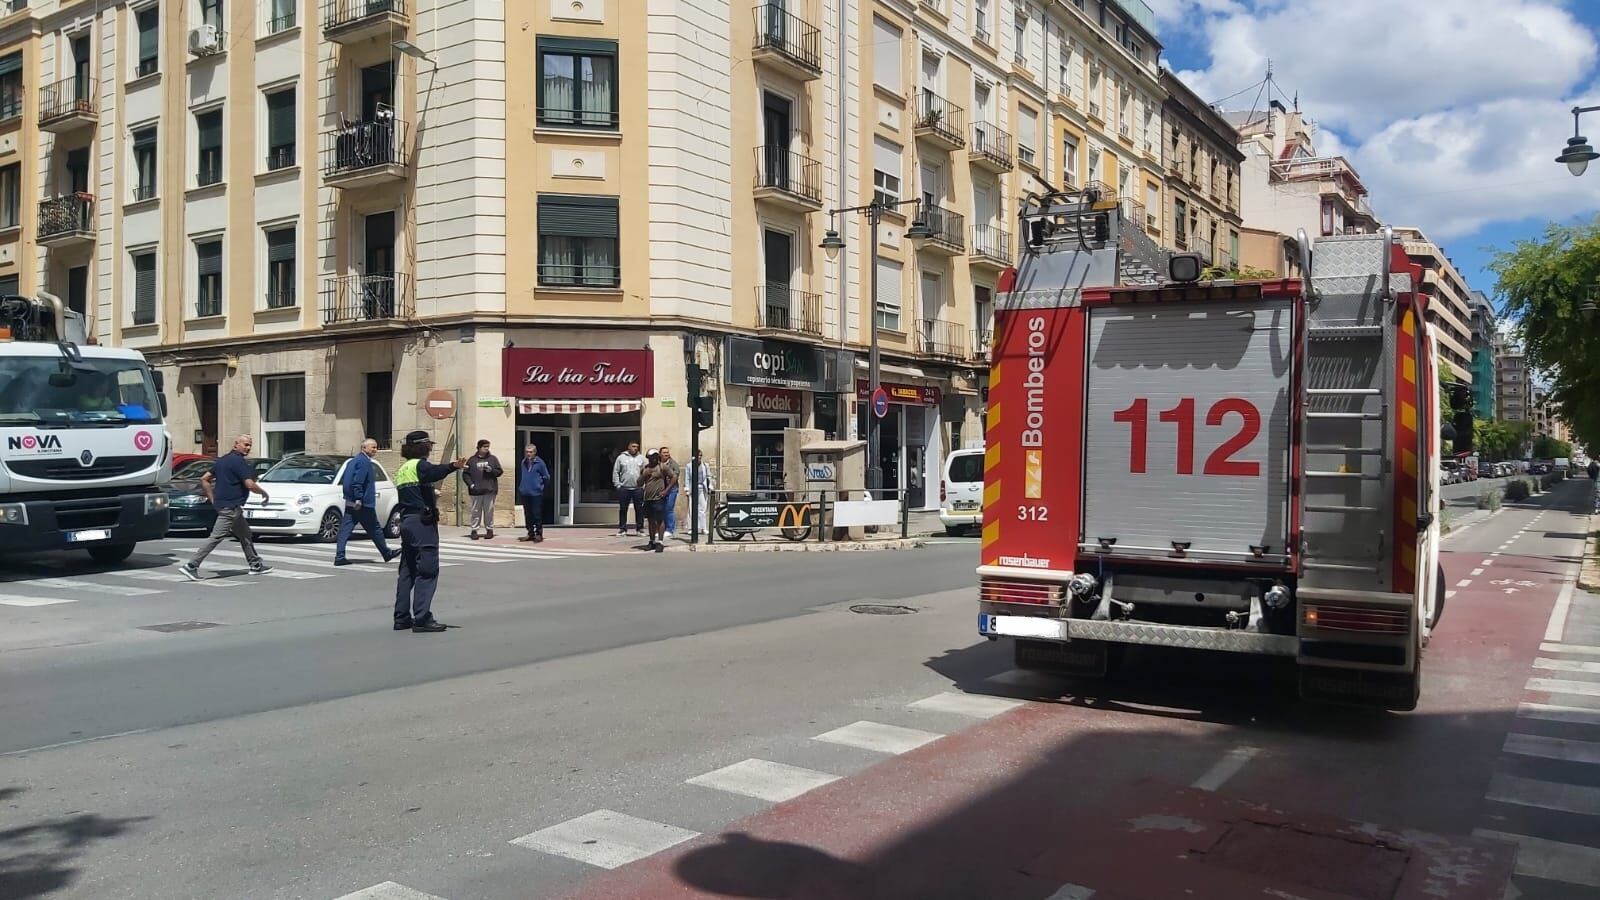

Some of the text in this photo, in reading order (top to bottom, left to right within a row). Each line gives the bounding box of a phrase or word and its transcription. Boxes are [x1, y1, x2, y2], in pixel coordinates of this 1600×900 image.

[522, 365, 554, 383] La
[589, 361, 639, 384] Tula
[1021, 316, 1045, 447] Bomberos
[757, 392, 792, 411] Kodak
[8, 435, 62, 450] NOVA
[1113, 397, 1262, 477] 112
[1017, 505, 1048, 521] 312
[999, 552, 1050, 569] rosenbauer
